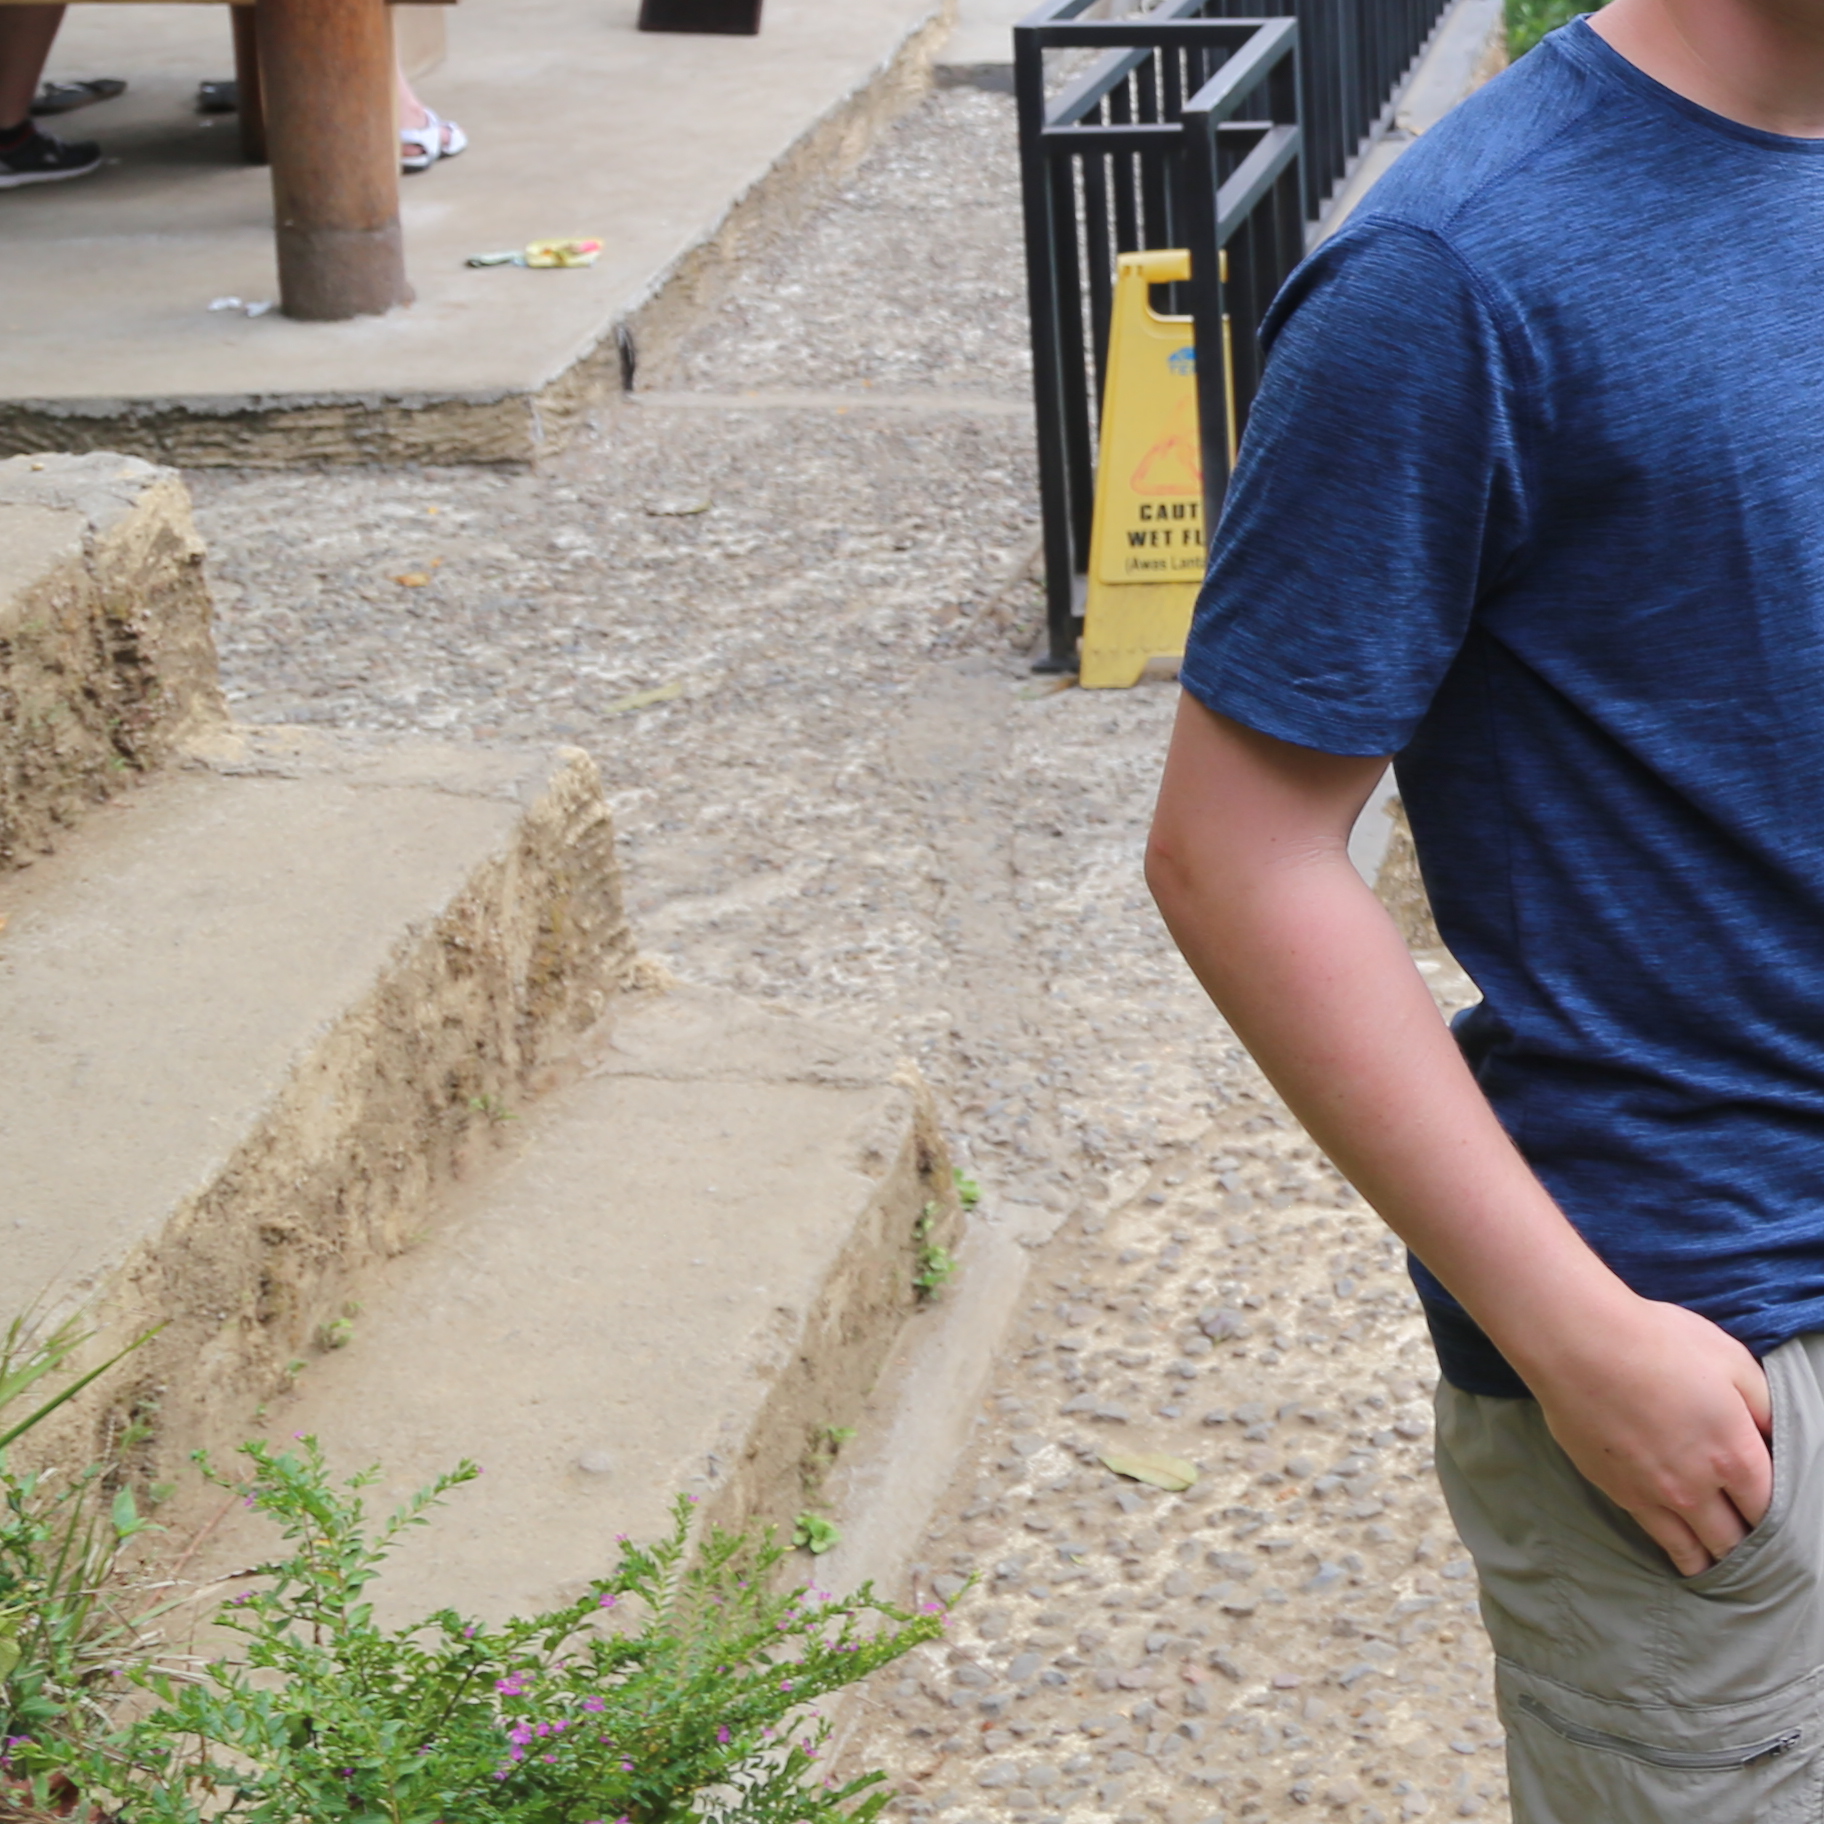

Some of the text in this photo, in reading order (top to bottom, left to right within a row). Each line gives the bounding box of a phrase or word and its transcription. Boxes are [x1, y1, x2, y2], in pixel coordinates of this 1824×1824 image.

[1139, 503, 1199, 521] CAUT
[1127, 529, 1205, 547] WET FL
